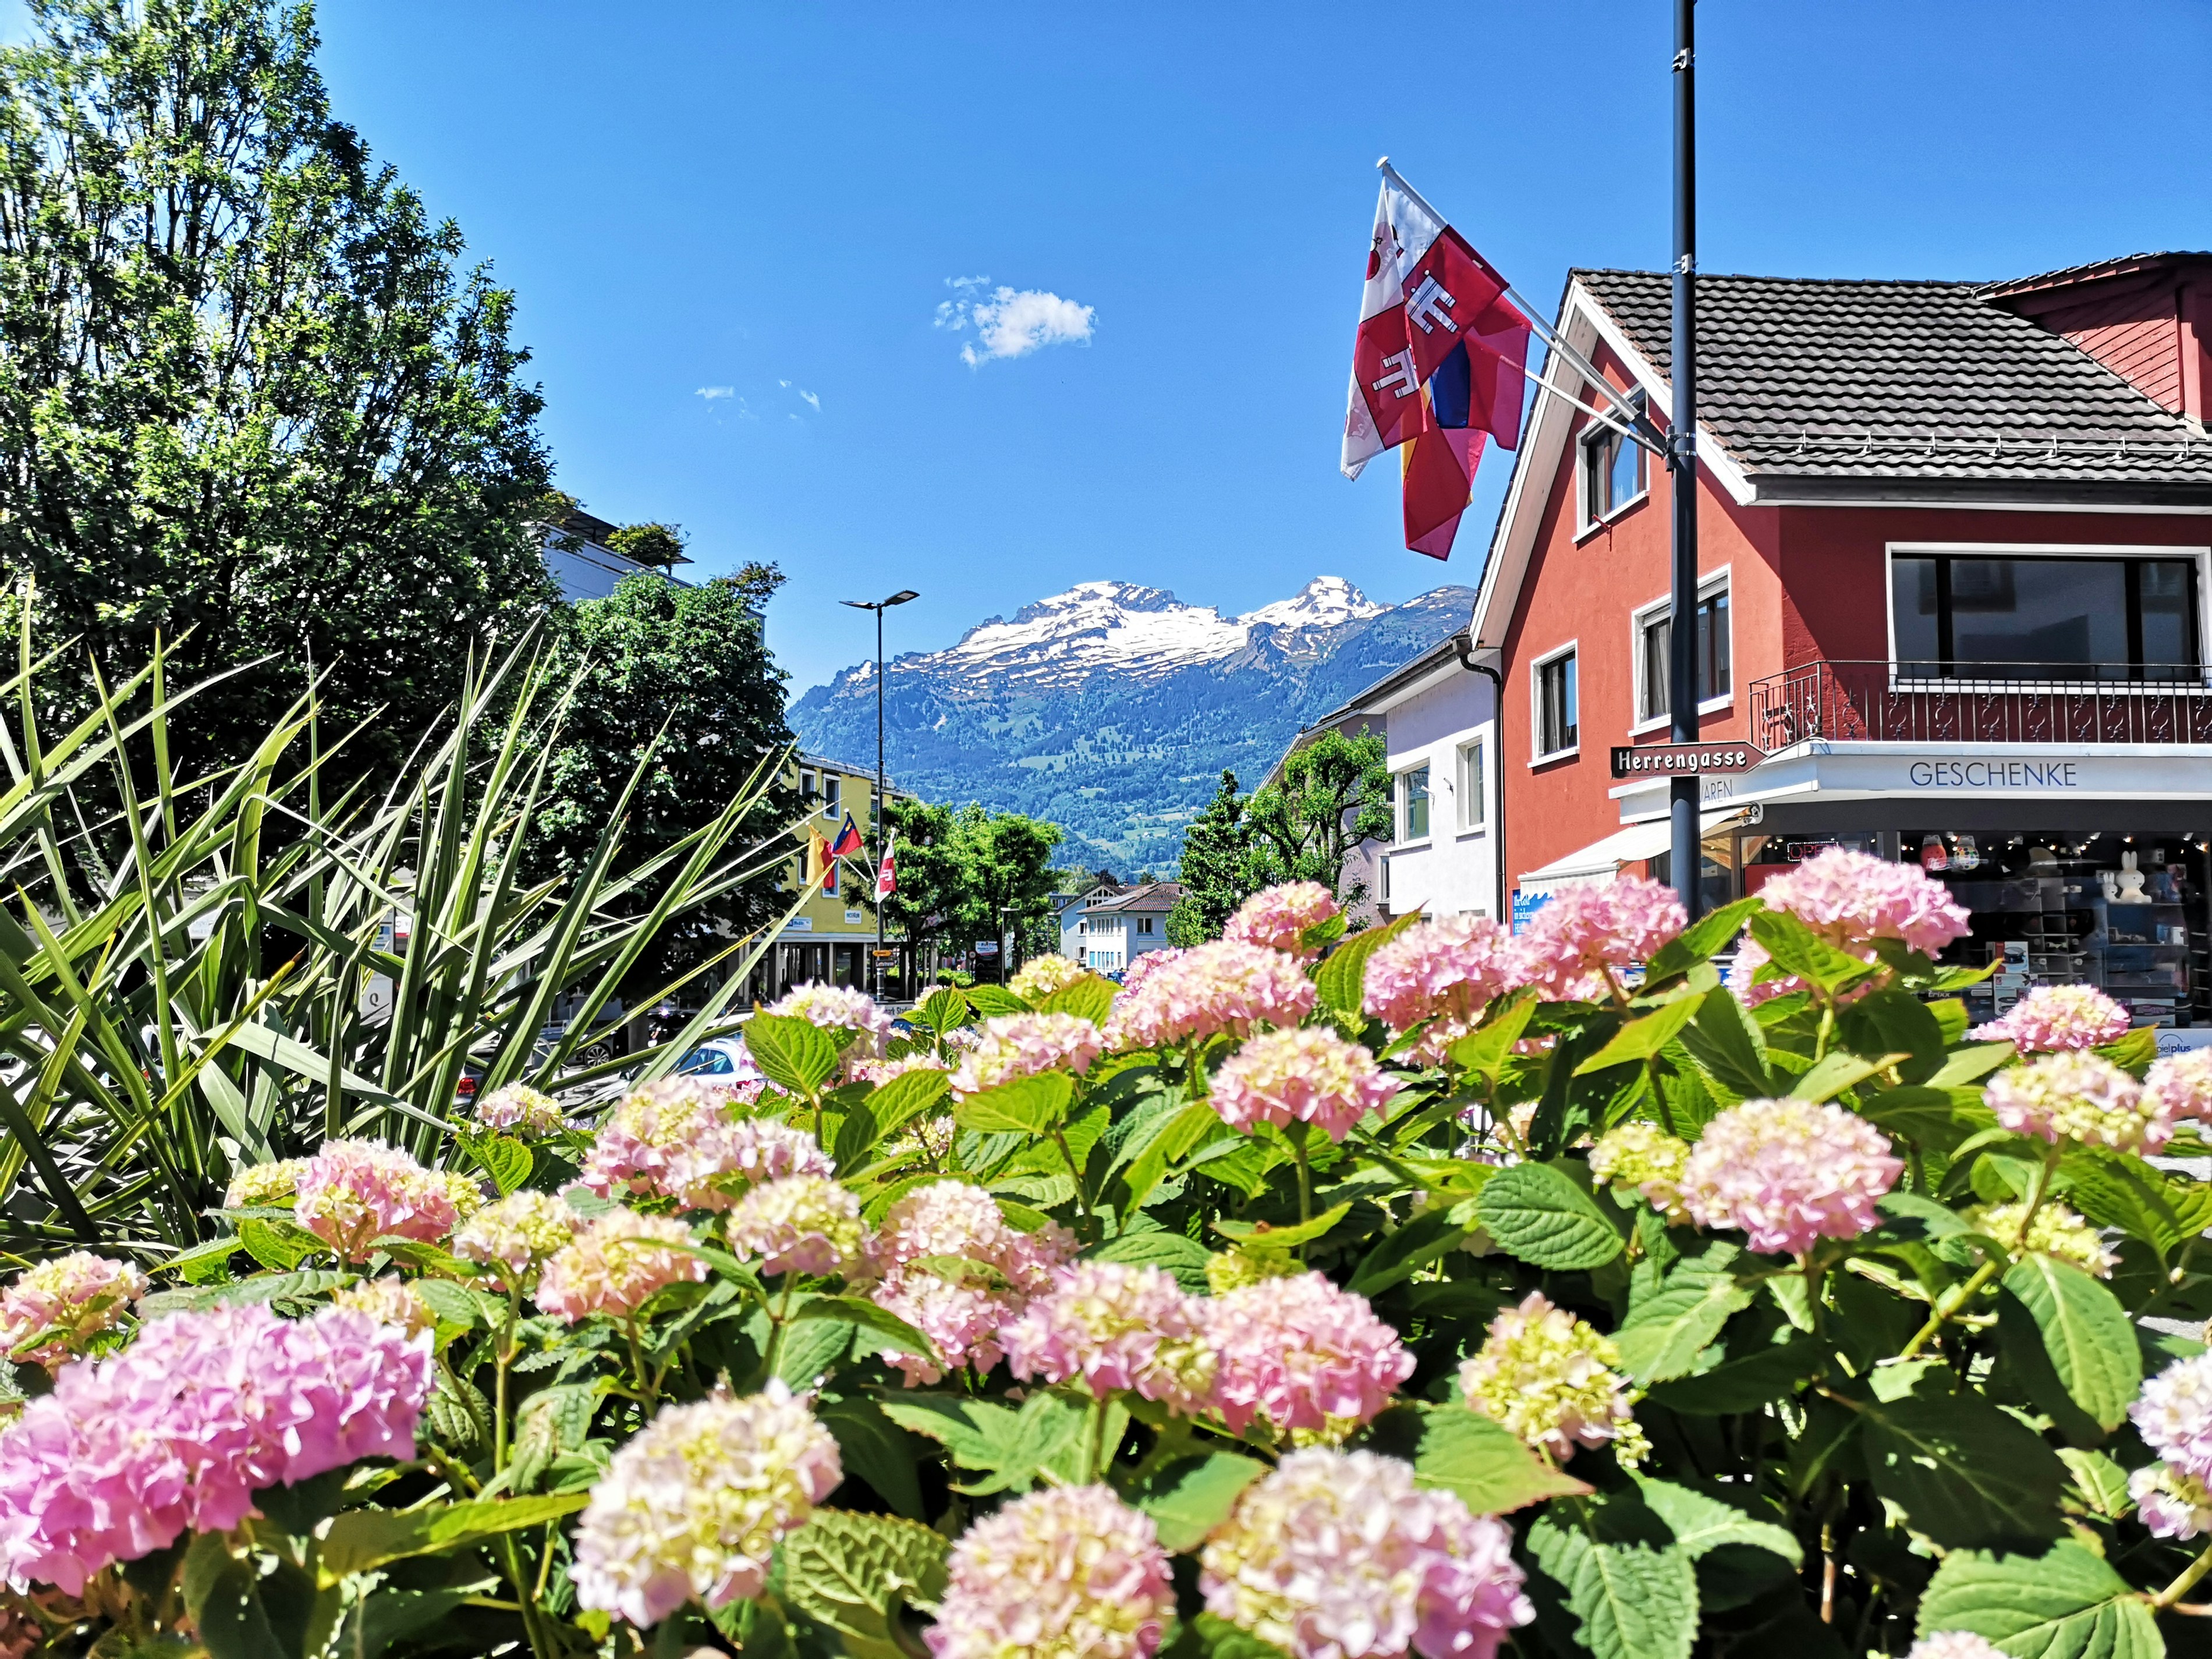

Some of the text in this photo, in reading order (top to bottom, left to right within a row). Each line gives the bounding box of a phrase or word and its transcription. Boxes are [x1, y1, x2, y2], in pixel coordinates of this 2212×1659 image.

[1618, 750, 1746, 772] Herrengasse
[1909, 761, 2077, 786] GESCHENKE
[1700, 779, 1733, 804] AREN
[1790, 843, 1837, 859] OPE
[2156, 1043, 2191, 1054] pielplus
